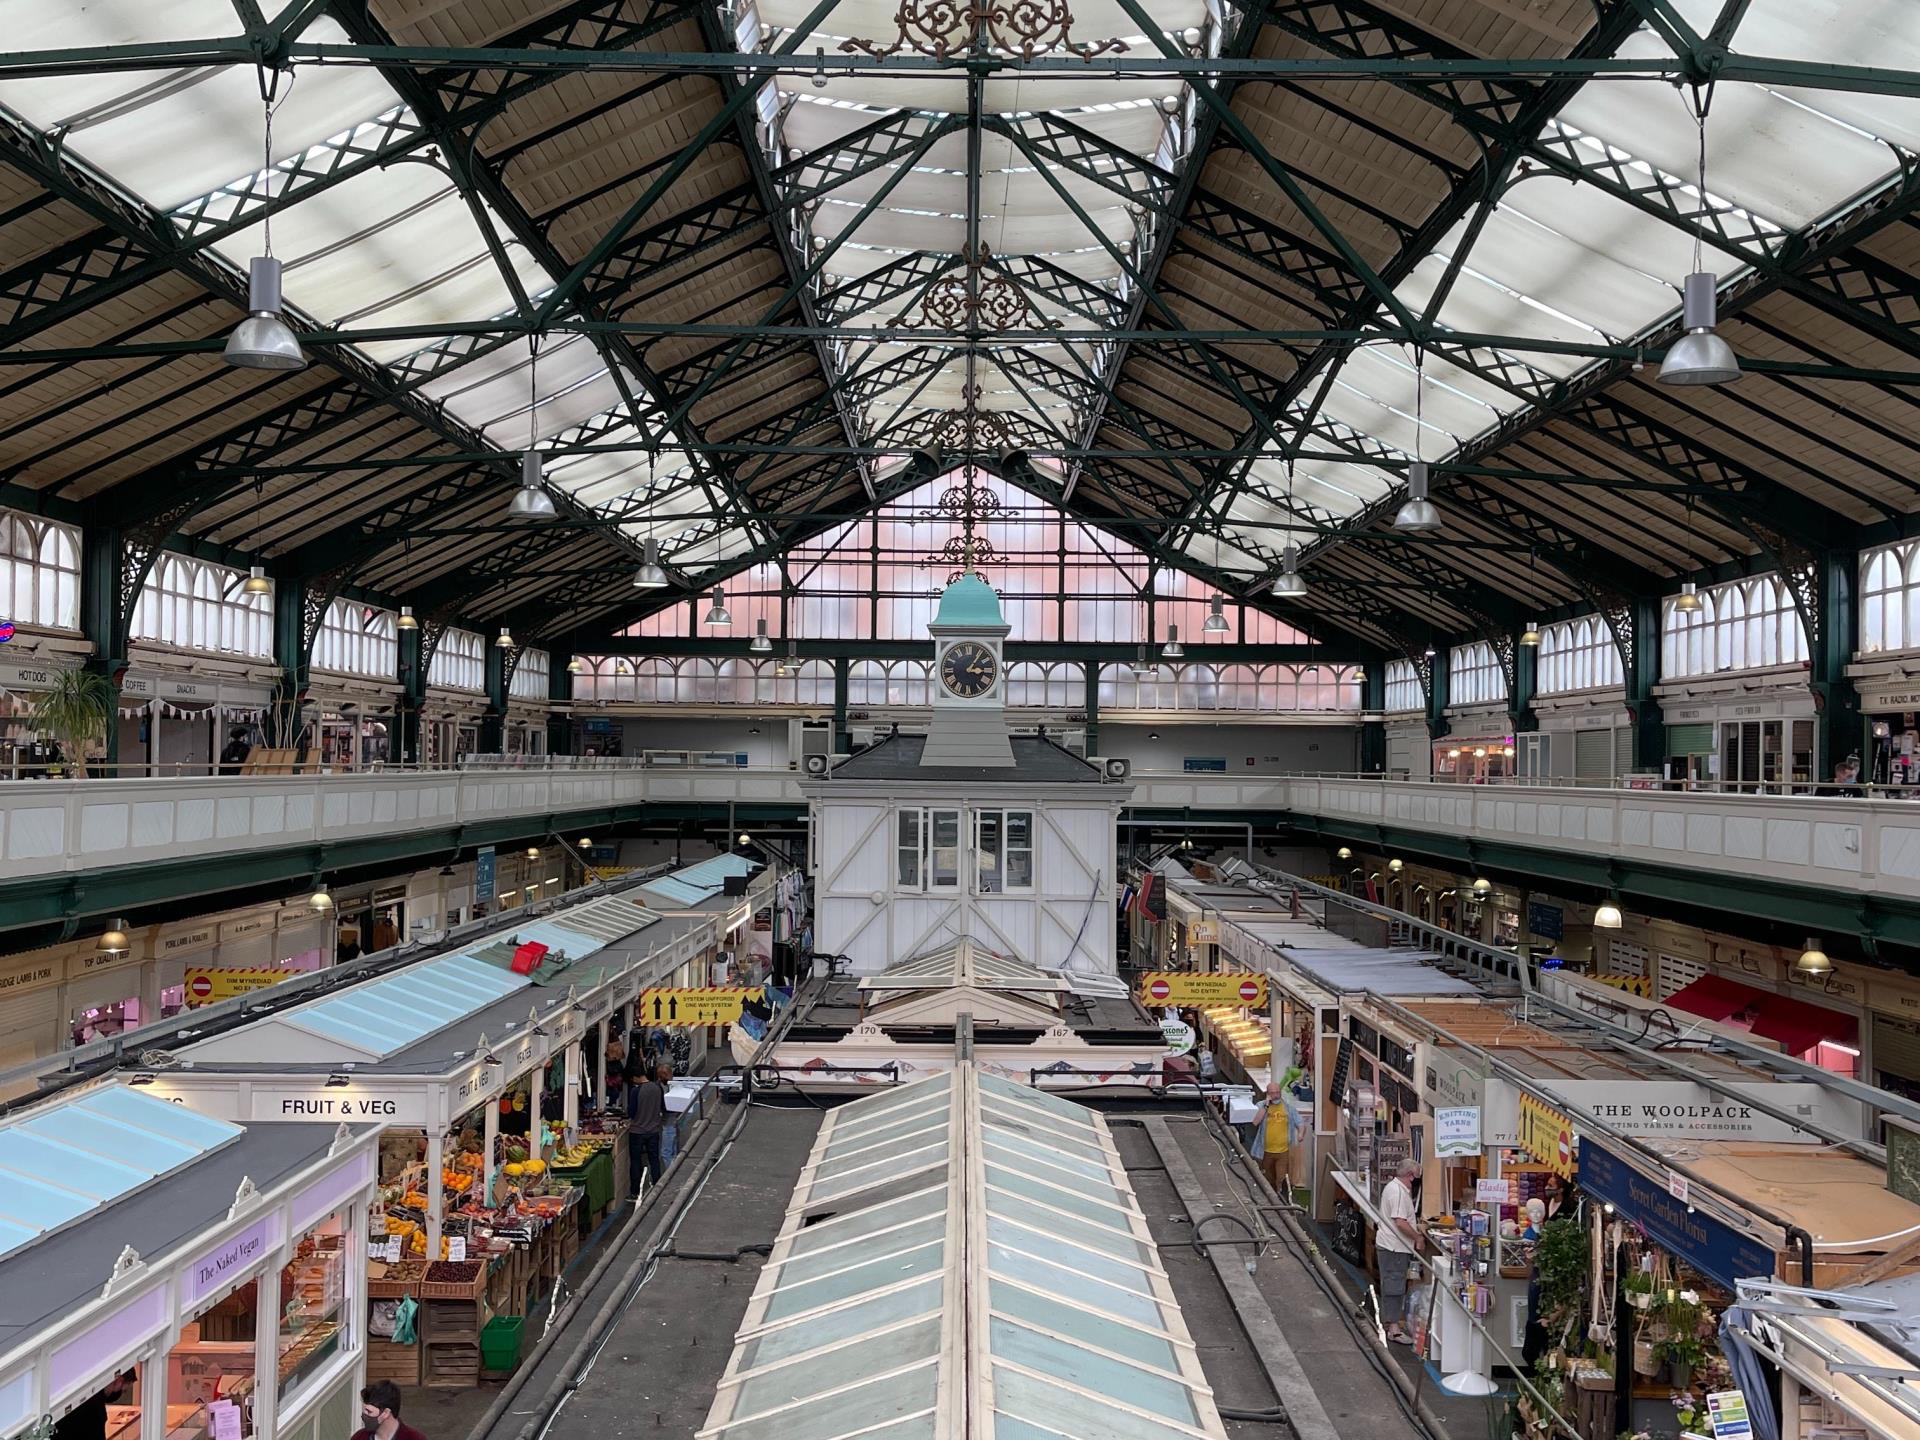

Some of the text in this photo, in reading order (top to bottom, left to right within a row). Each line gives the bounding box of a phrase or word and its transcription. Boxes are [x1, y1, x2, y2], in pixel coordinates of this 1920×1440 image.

[125, 680, 147, 691] COFFEE
[176, 685, 196, 694] SNACKS
[1890, 696, 1908, 704] RADIO
[84, 958, 95, 968] TOP
[96, 952, 117, 966] QUALITY
[38, 968, 52, 980] PORK
[860, 1026, 876, 1034] 170
[1053, 1029, 1068, 1038] 167
[460, 1080, 474, 1098] FRUIT
[478, 1071, 489, 1087] VEG
[282, 1100, 396, 1114] FRUIT & VEG
[1592, 1105, 1752, 1118] THE WOOLPACK
[1438, 1110, 1477, 1120] KNITTING
[1688, 1123, 1752, 1131] ACCESSORIES
[1478, 1180, 1507, 1192] Elastic
[1629, 1178, 1651, 1206] Secret
[1651, 1191, 1678, 1229] Garden
[1679, 1211, 1708, 1246] Florist
[200, 1236, 260, 1284] The Naked Vegan
